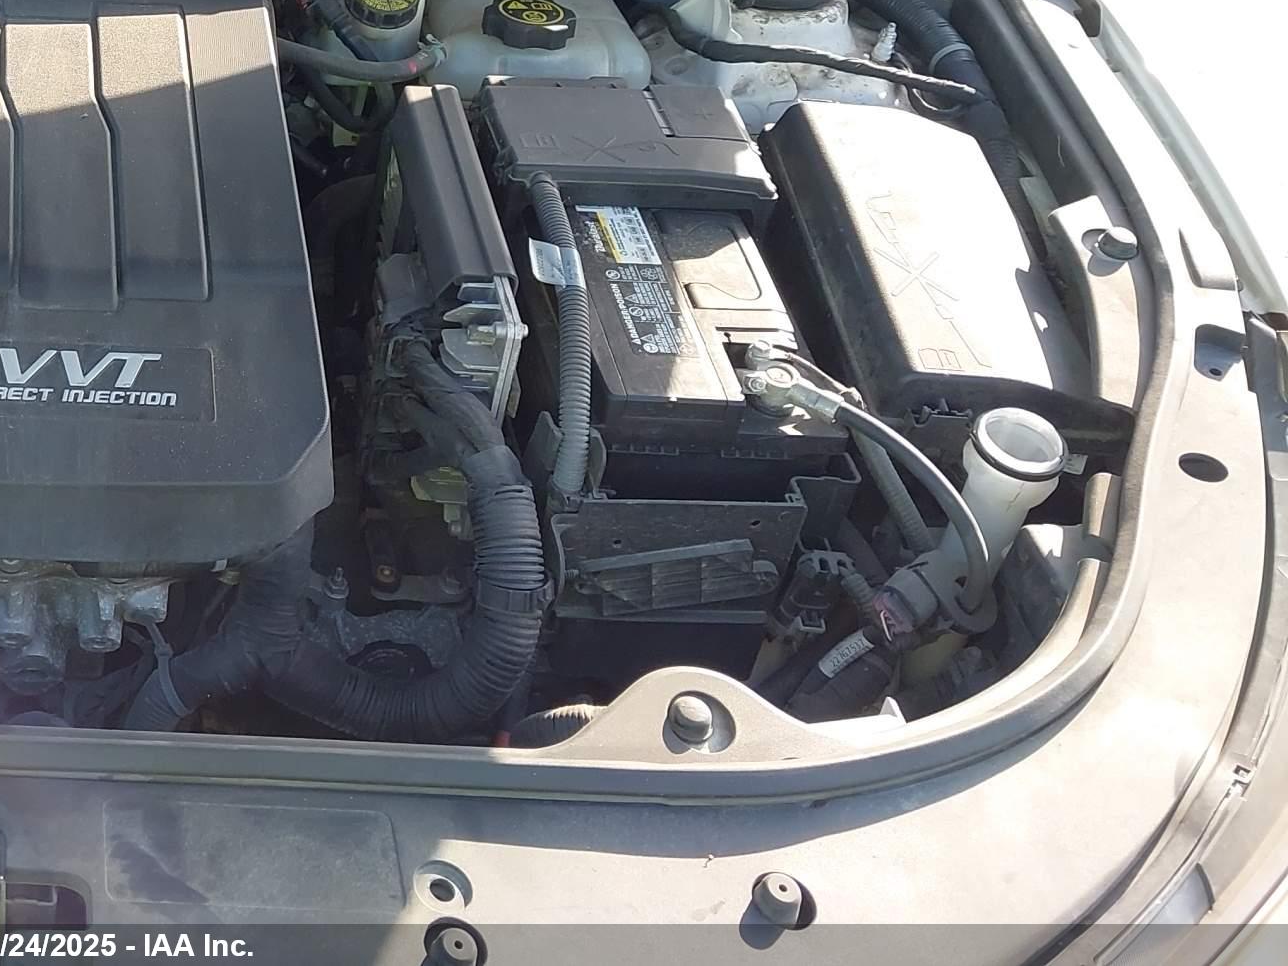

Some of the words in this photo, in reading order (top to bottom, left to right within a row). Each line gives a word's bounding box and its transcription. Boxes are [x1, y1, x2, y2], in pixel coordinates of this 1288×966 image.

[610, 283, 640, 339] DANGER/POISON
[0, 348, 162, 388] VVT
[61, 388, 177, 407] INJECTION
